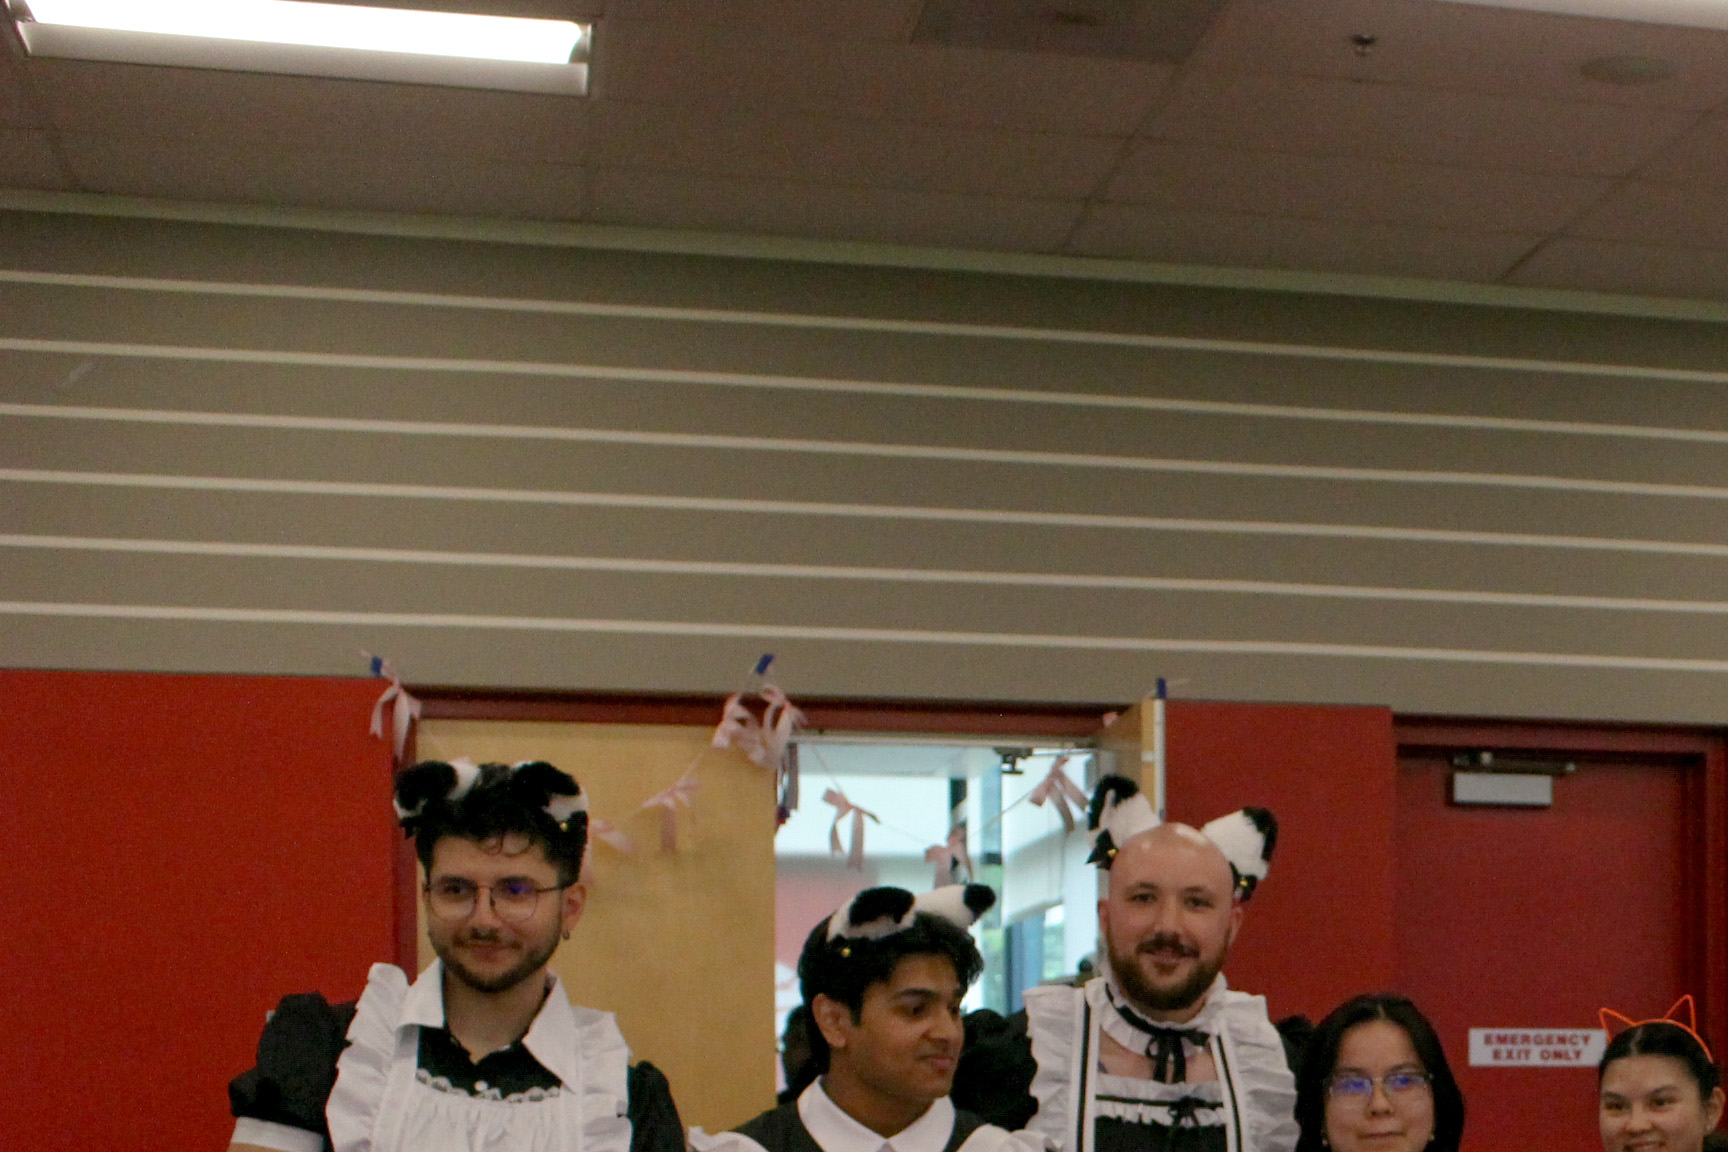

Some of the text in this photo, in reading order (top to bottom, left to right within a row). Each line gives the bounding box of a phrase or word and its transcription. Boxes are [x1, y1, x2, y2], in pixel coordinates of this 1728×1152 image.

[1483, 1033, 1591, 1046] EMERGENCY
[1492, 1048, 1583, 1061] EXIT ONLY
